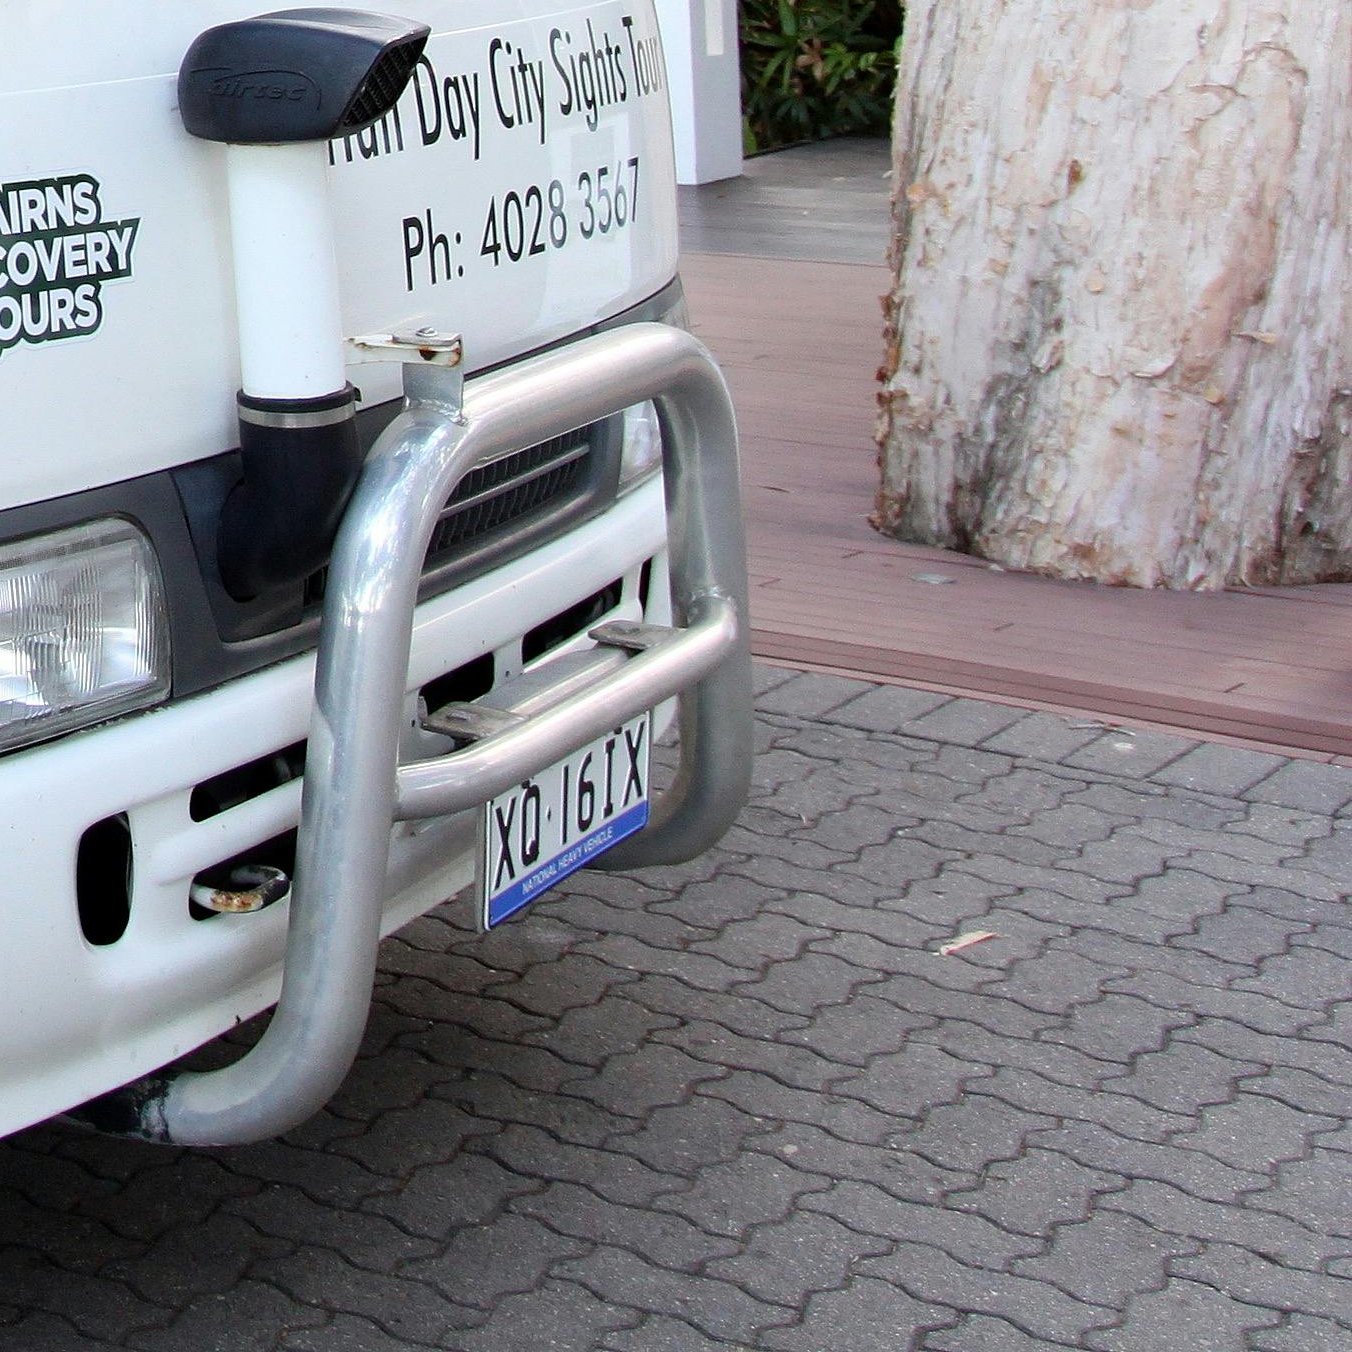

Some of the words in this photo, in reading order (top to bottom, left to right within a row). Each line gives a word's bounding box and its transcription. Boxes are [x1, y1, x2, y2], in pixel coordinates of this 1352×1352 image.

[413, 53, 479, 160] Day
[489, 38, 547, 144] City
[550, 18, 628, 131] Sights
[402, 208, 464, 292] Ph:
[480, 179, 567, 266] 4028
[578, 157, 639, 239] 3567
[521, 862, 557, 895] NATIONAL
[558, 847, 583, 871] HEAVY
[583, 826, 614, 854] VEHICLE
